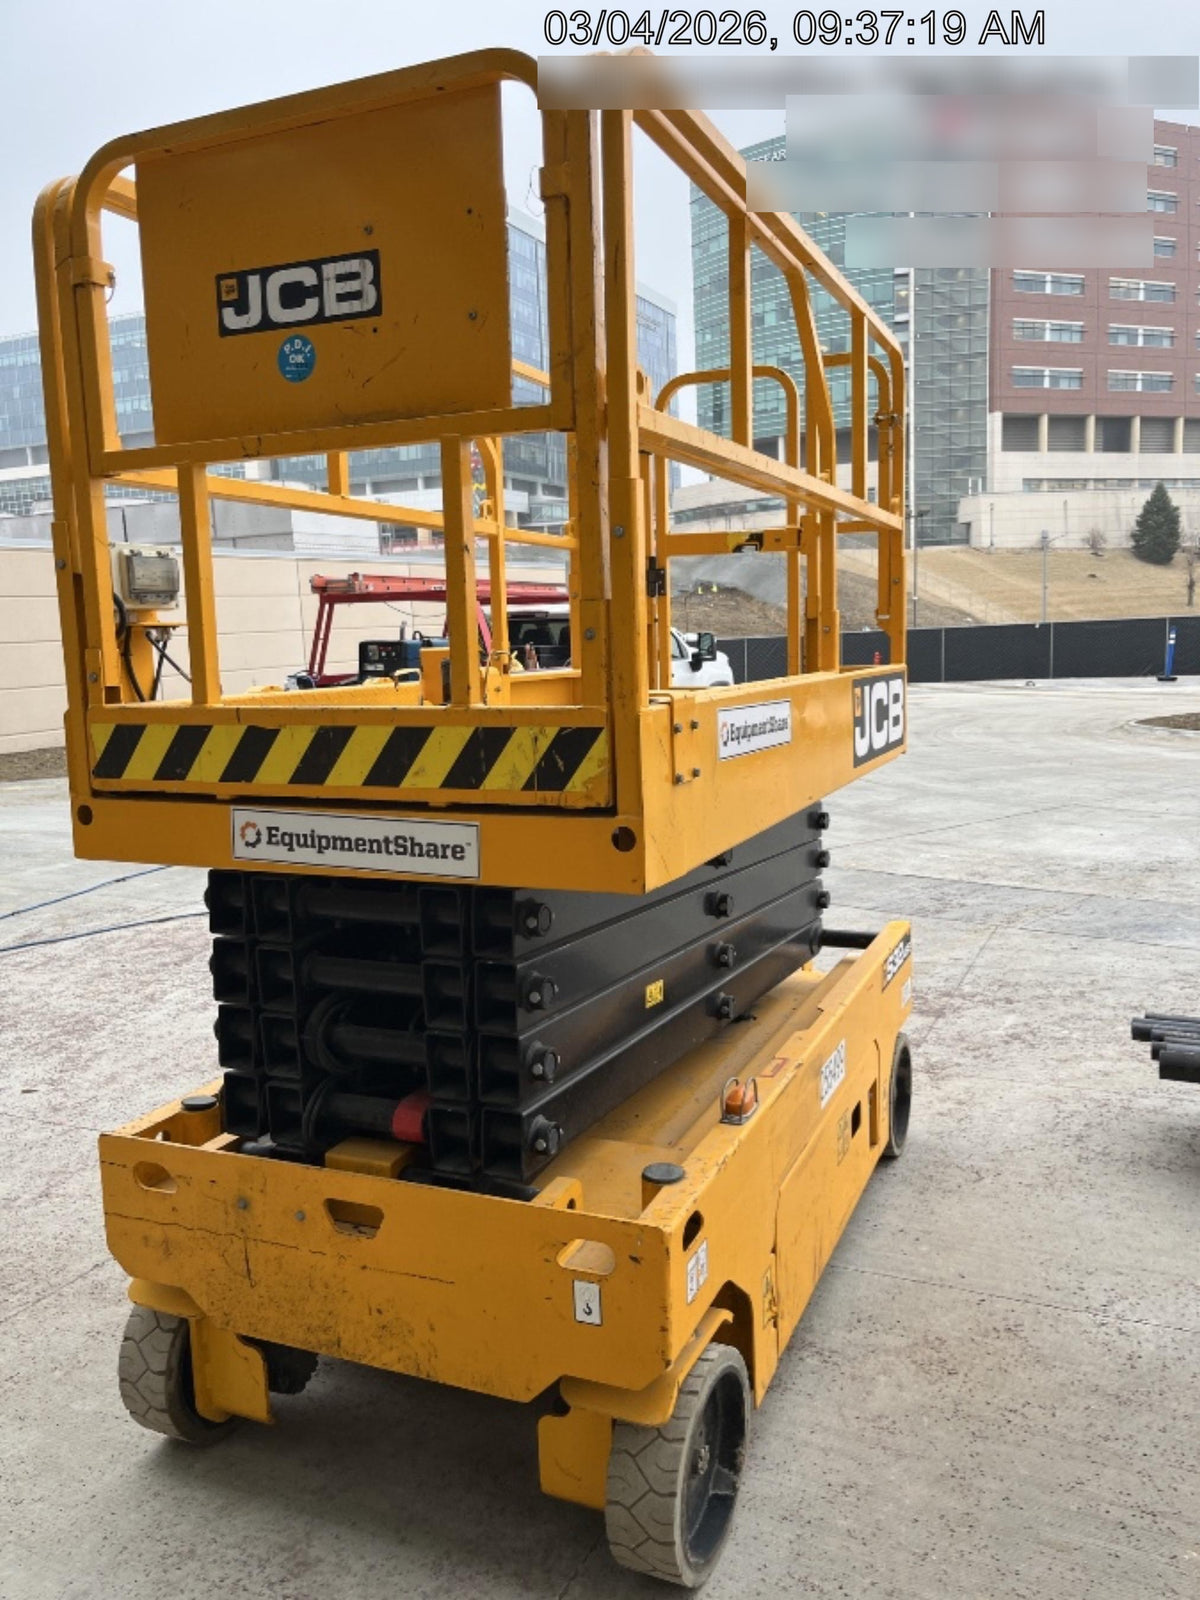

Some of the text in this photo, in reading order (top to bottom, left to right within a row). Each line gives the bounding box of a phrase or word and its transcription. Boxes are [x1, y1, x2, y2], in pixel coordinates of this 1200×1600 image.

[221, 258, 377, 330] JCB
[854, 678, 905, 758] JCB
[265, 825, 467, 861] EquipmentShare
